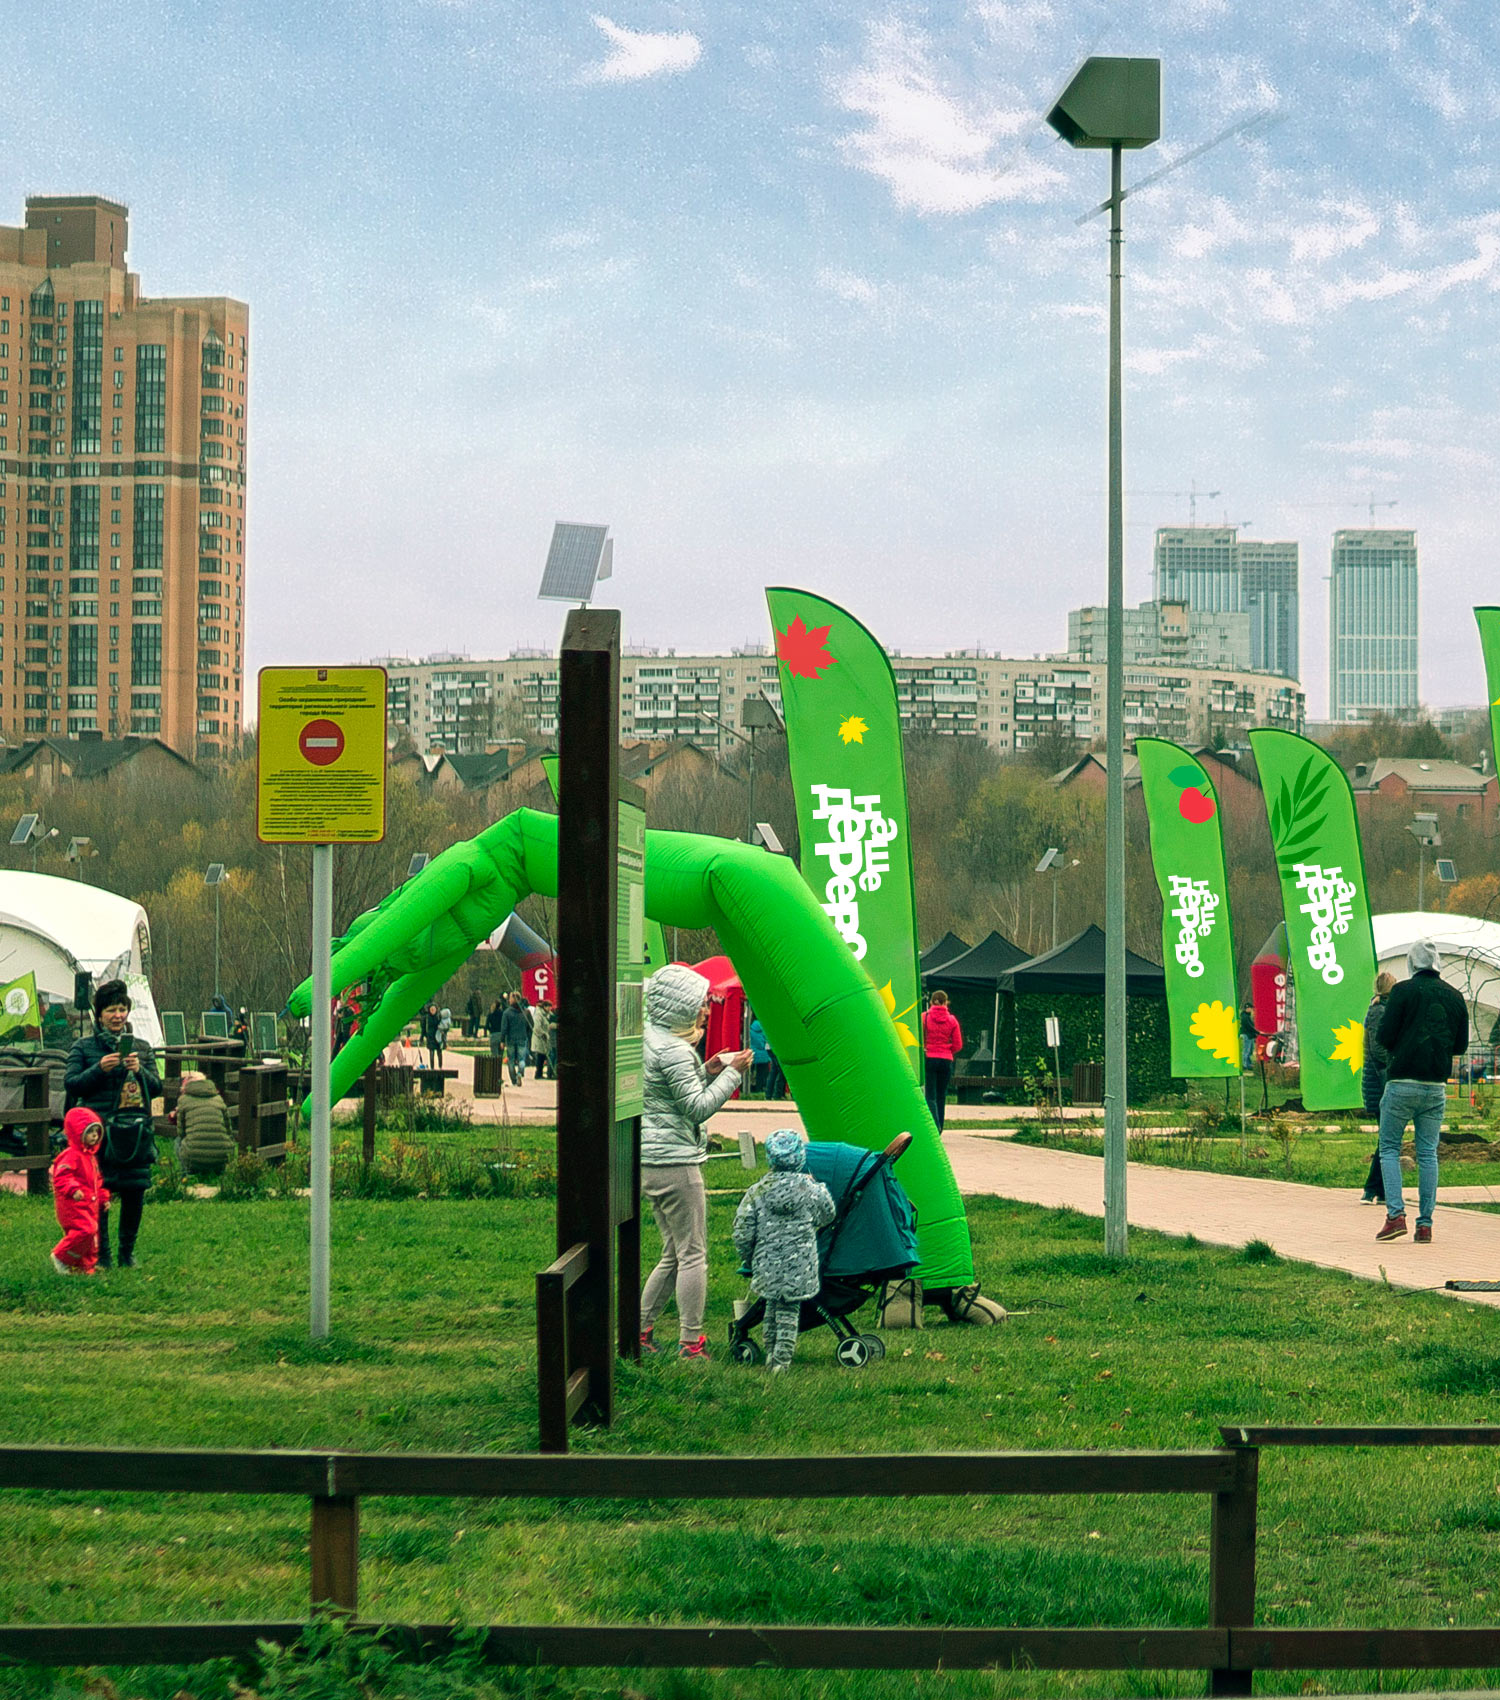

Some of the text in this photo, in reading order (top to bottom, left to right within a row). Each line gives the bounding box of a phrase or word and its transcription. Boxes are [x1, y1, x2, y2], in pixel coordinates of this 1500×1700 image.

[854, 794, 898, 892] наше
[1168, 875, 1205, 978] дерево
[1193, 880, 1220, 937] наше
[1292, 863, 1345, 986] дерево
[1322, 866, 1357, 935] наше
